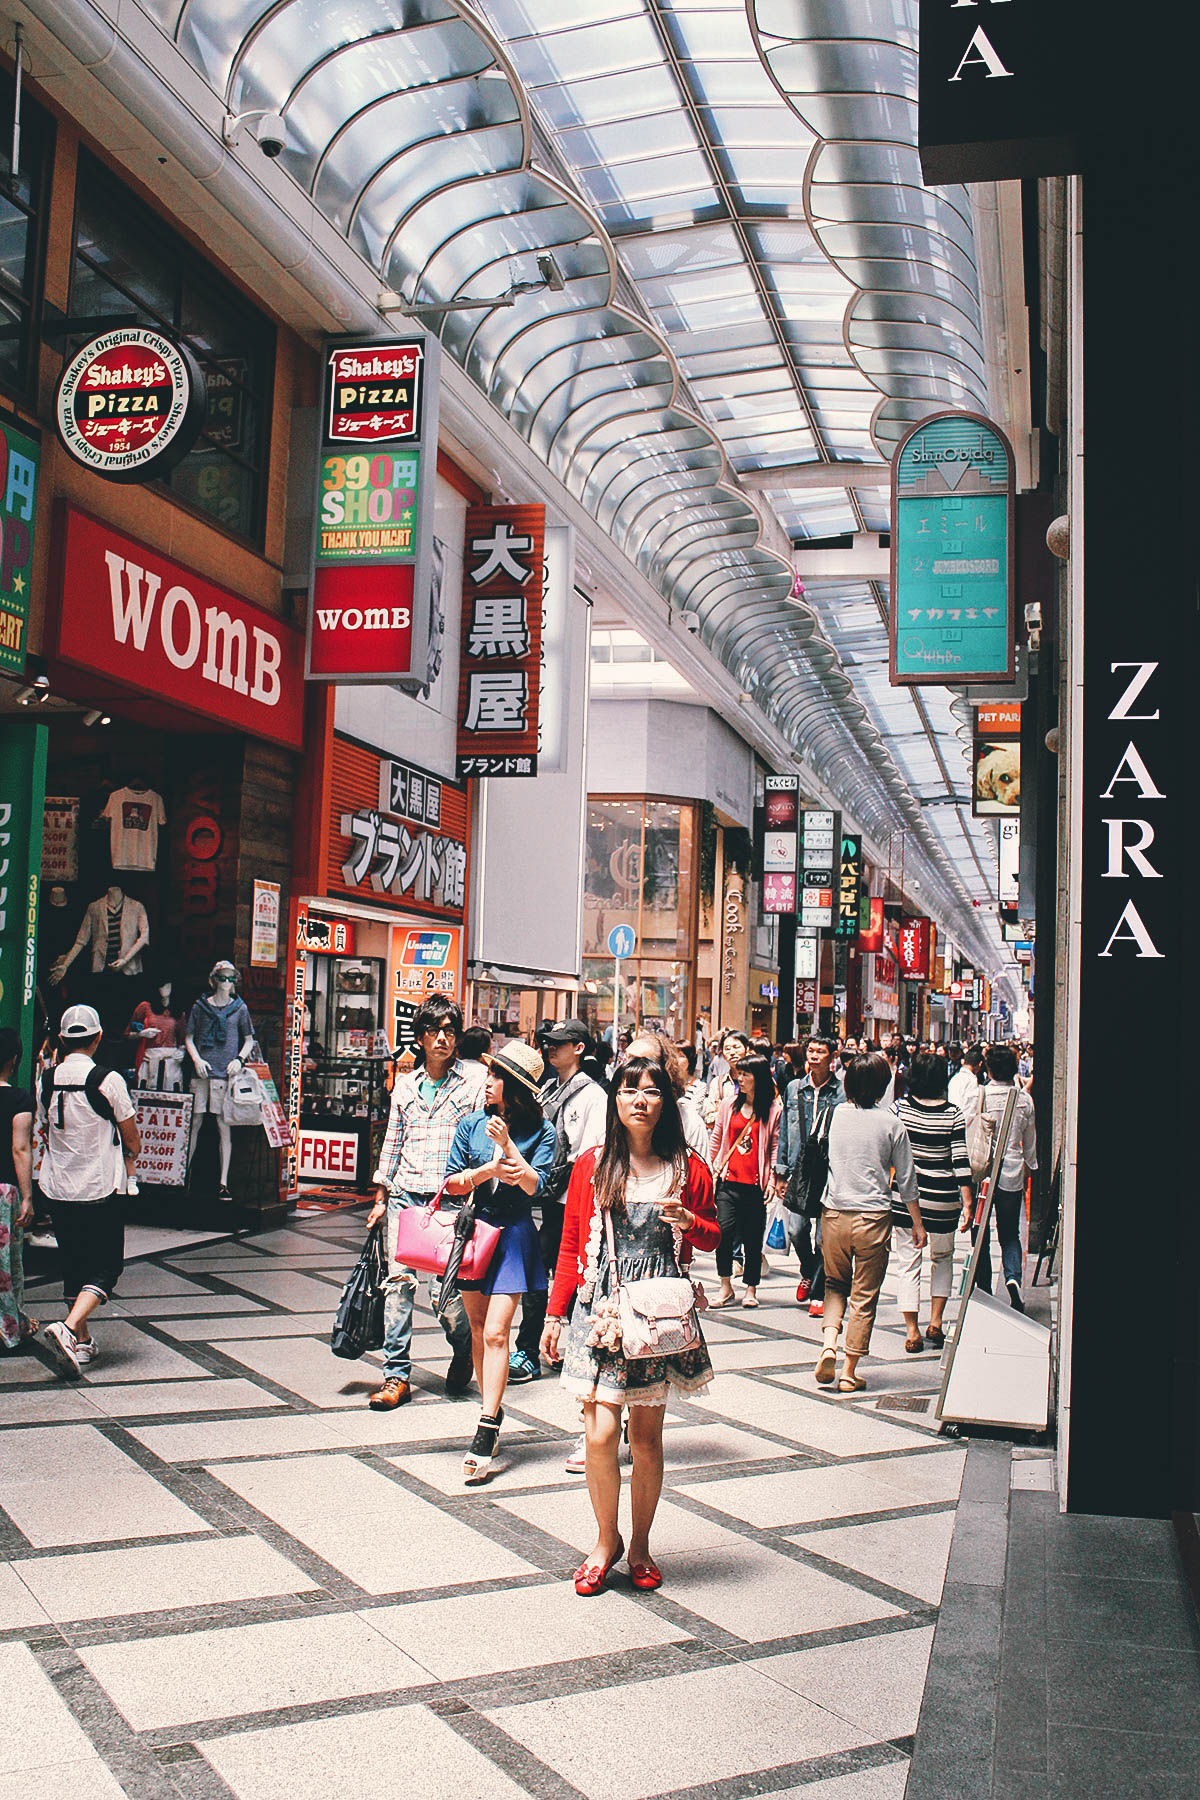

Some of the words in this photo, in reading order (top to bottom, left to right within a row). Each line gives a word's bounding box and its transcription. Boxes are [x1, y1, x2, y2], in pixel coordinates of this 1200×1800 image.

[63, 351, 95, 396] Shakey's
[95, 331, 140, 353] Original
[143, 332, 174, 359] Crispy
[170, 357, 184, 389] Pizza
[85, 362, 166, 388] Shakey's
[337, 355, 414, 379] Shakey's
[63, 406, 77, 439] Pizza
[85, 416, 159, 437] シェーキーズ
[151, 401, 184, 450] Shakey's
[338, 412, 409, 432] シェーキーズ
[74, 436, 101, 464] Crispy
[105, 448, 150, 467] Original
[109, 442, 131, 452] 1954
[323, 454, 417, 490] 390円
[321, 488, 415, 525] SHOP
[916, 515, 987, 534] エミール
[322, 531, 357, 549] THANK
[358, 530, 380, 547] YOU
[381, 528, 412, 547] MART
[464, 522, 535, 733] 大黒屋
[978, 713, 997, 722] PET
[461, 757, 531, 774] ブランド館
[391, 770, 440, 823] 大黒屋
[1098, 662, 1167, 958] ZARA
[347, 811, 467, 908] ブランド館
[407, 939, 447, 955] UnionPay
[136, 1113, 183, 1128] SALE
[139, 1129, 177, 1142] 10%OFF
[135, 1159, 174, 1172] 20%OFF
[301, 1136, 355, 1173] FREE
